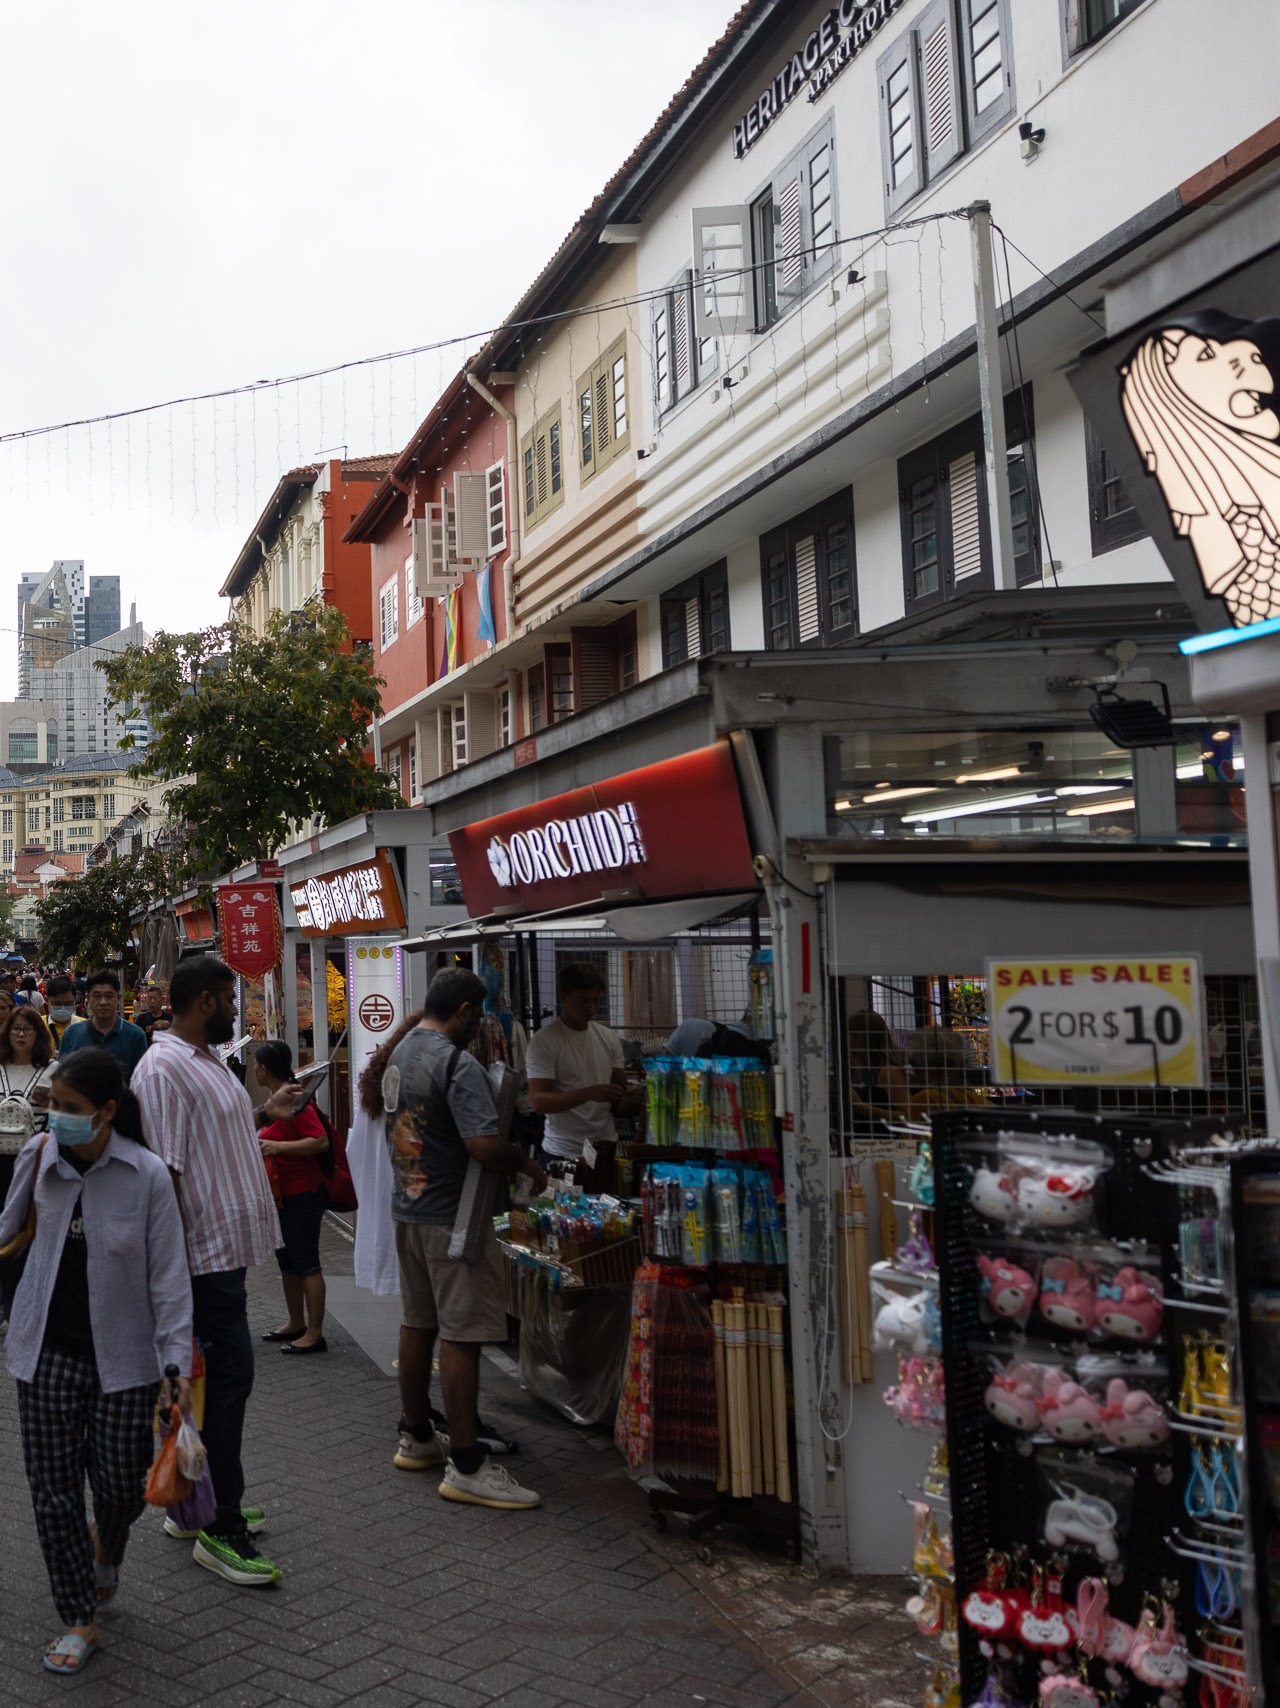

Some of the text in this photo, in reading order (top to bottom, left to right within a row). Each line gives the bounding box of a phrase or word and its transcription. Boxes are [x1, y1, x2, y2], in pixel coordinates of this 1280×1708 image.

[732, 9, 840, 158] HERITAGE
[510, 808, 628, 884] ORCHID
[238, 904, 262, 953] 吉祥苑
[996, 968, 1074, 987] SALE
[1091, 965, 1174, 984] SALE
[1008, 1005, 1035, 1044] 2
[1040, 1012, 1098, 1038] FOR
